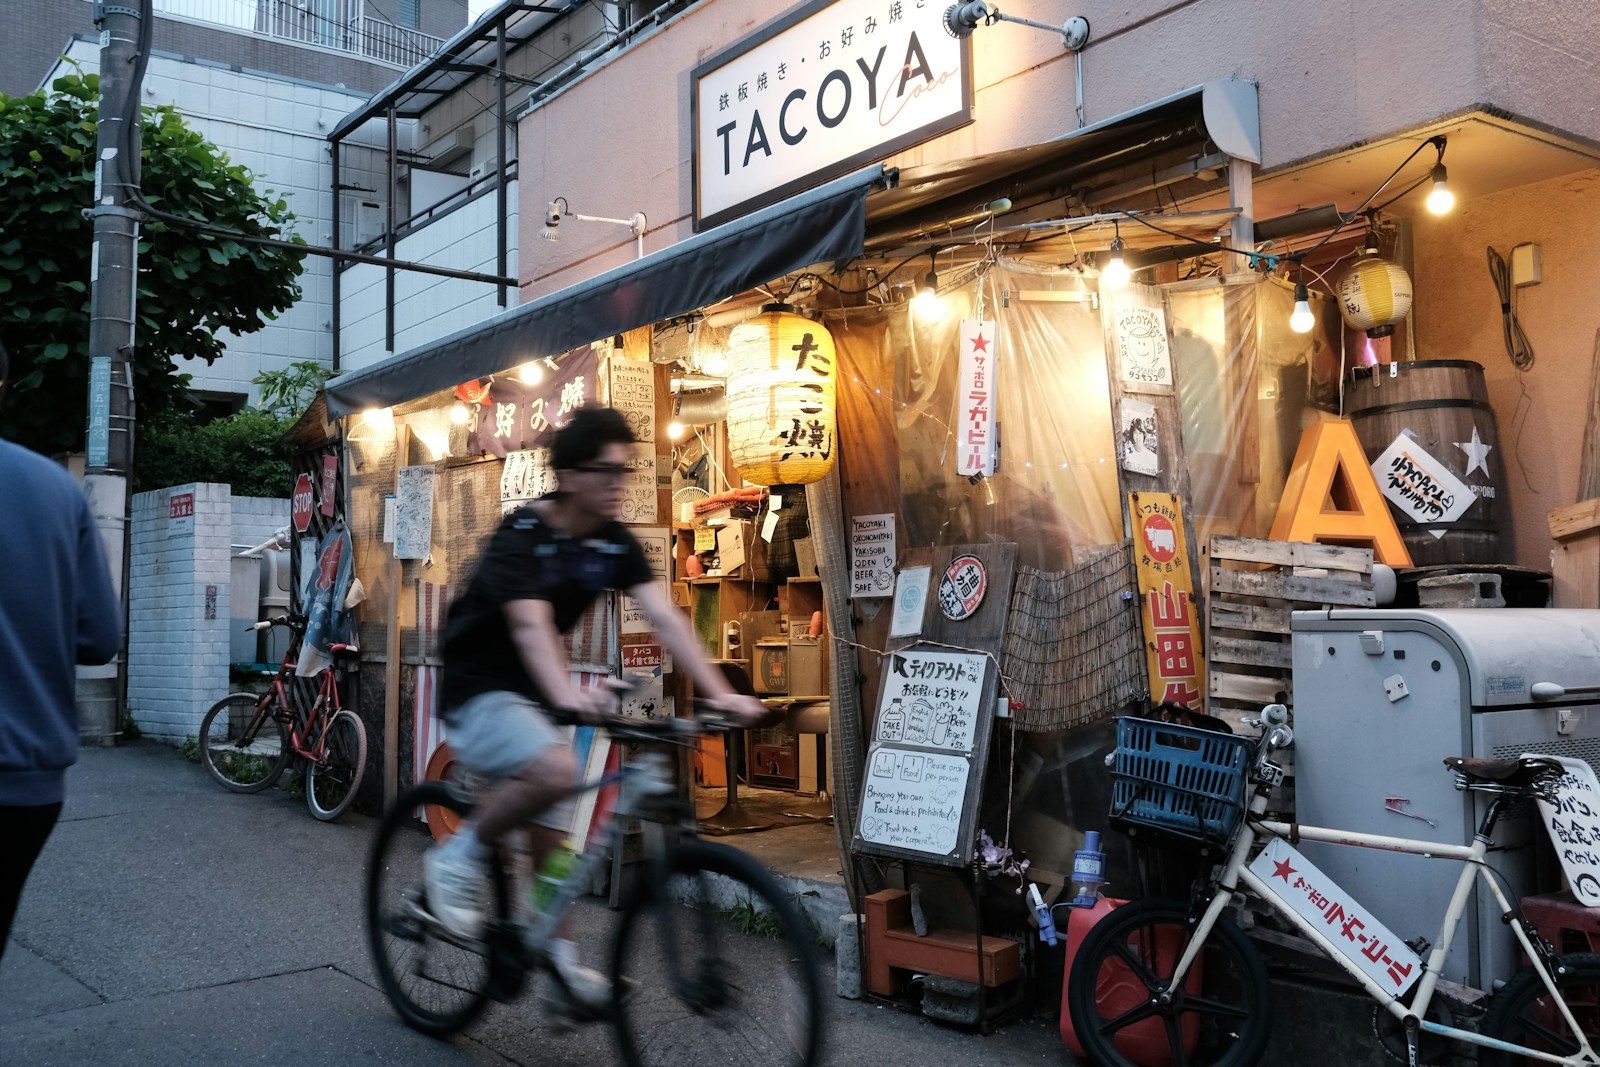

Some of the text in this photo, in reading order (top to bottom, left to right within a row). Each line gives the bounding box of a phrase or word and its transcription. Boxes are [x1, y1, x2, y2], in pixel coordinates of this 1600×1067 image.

[879, 63, 959, 127] Coco
[717, 30, 934, 176] TACOYA
[779, 332, 832, 462] たこ焼
[966, 356, 988, 470] サッポロラガービール
[1271, 419, 1414, 570] A
[294, 491, 312, 514] STOP
[854, 520, 886, 531] TACOYAKI
[853, 532, 893, 543] OKONOMIYAKI
[855, 547, 886, 556] YAKISOBA
[855, 559, 876, 568] ODEN
[855, 570, 874, 580] BEER
[855, 583, 872, 593] SAKE
[633, 647, 652, 656] タバコ
[910, 660, 966, 681] テイクアウト
[968, 674, 978, 683] OK
[883, 721, 900, 730] TAKE
[950, 714, 967, 727] Beer
[882, 731, 896, 739] OUT
[926, 758, 947, 769] Please
[875, 765, 891, 774] Drink
[904, 768, 919, 777] Food
[867, 785, 895, 801] Bringing
[874, 801, 888, 814] Food
[894, 806, 910, 816] drink
[1293, 876, 1413, 987] サッポロラガービール
